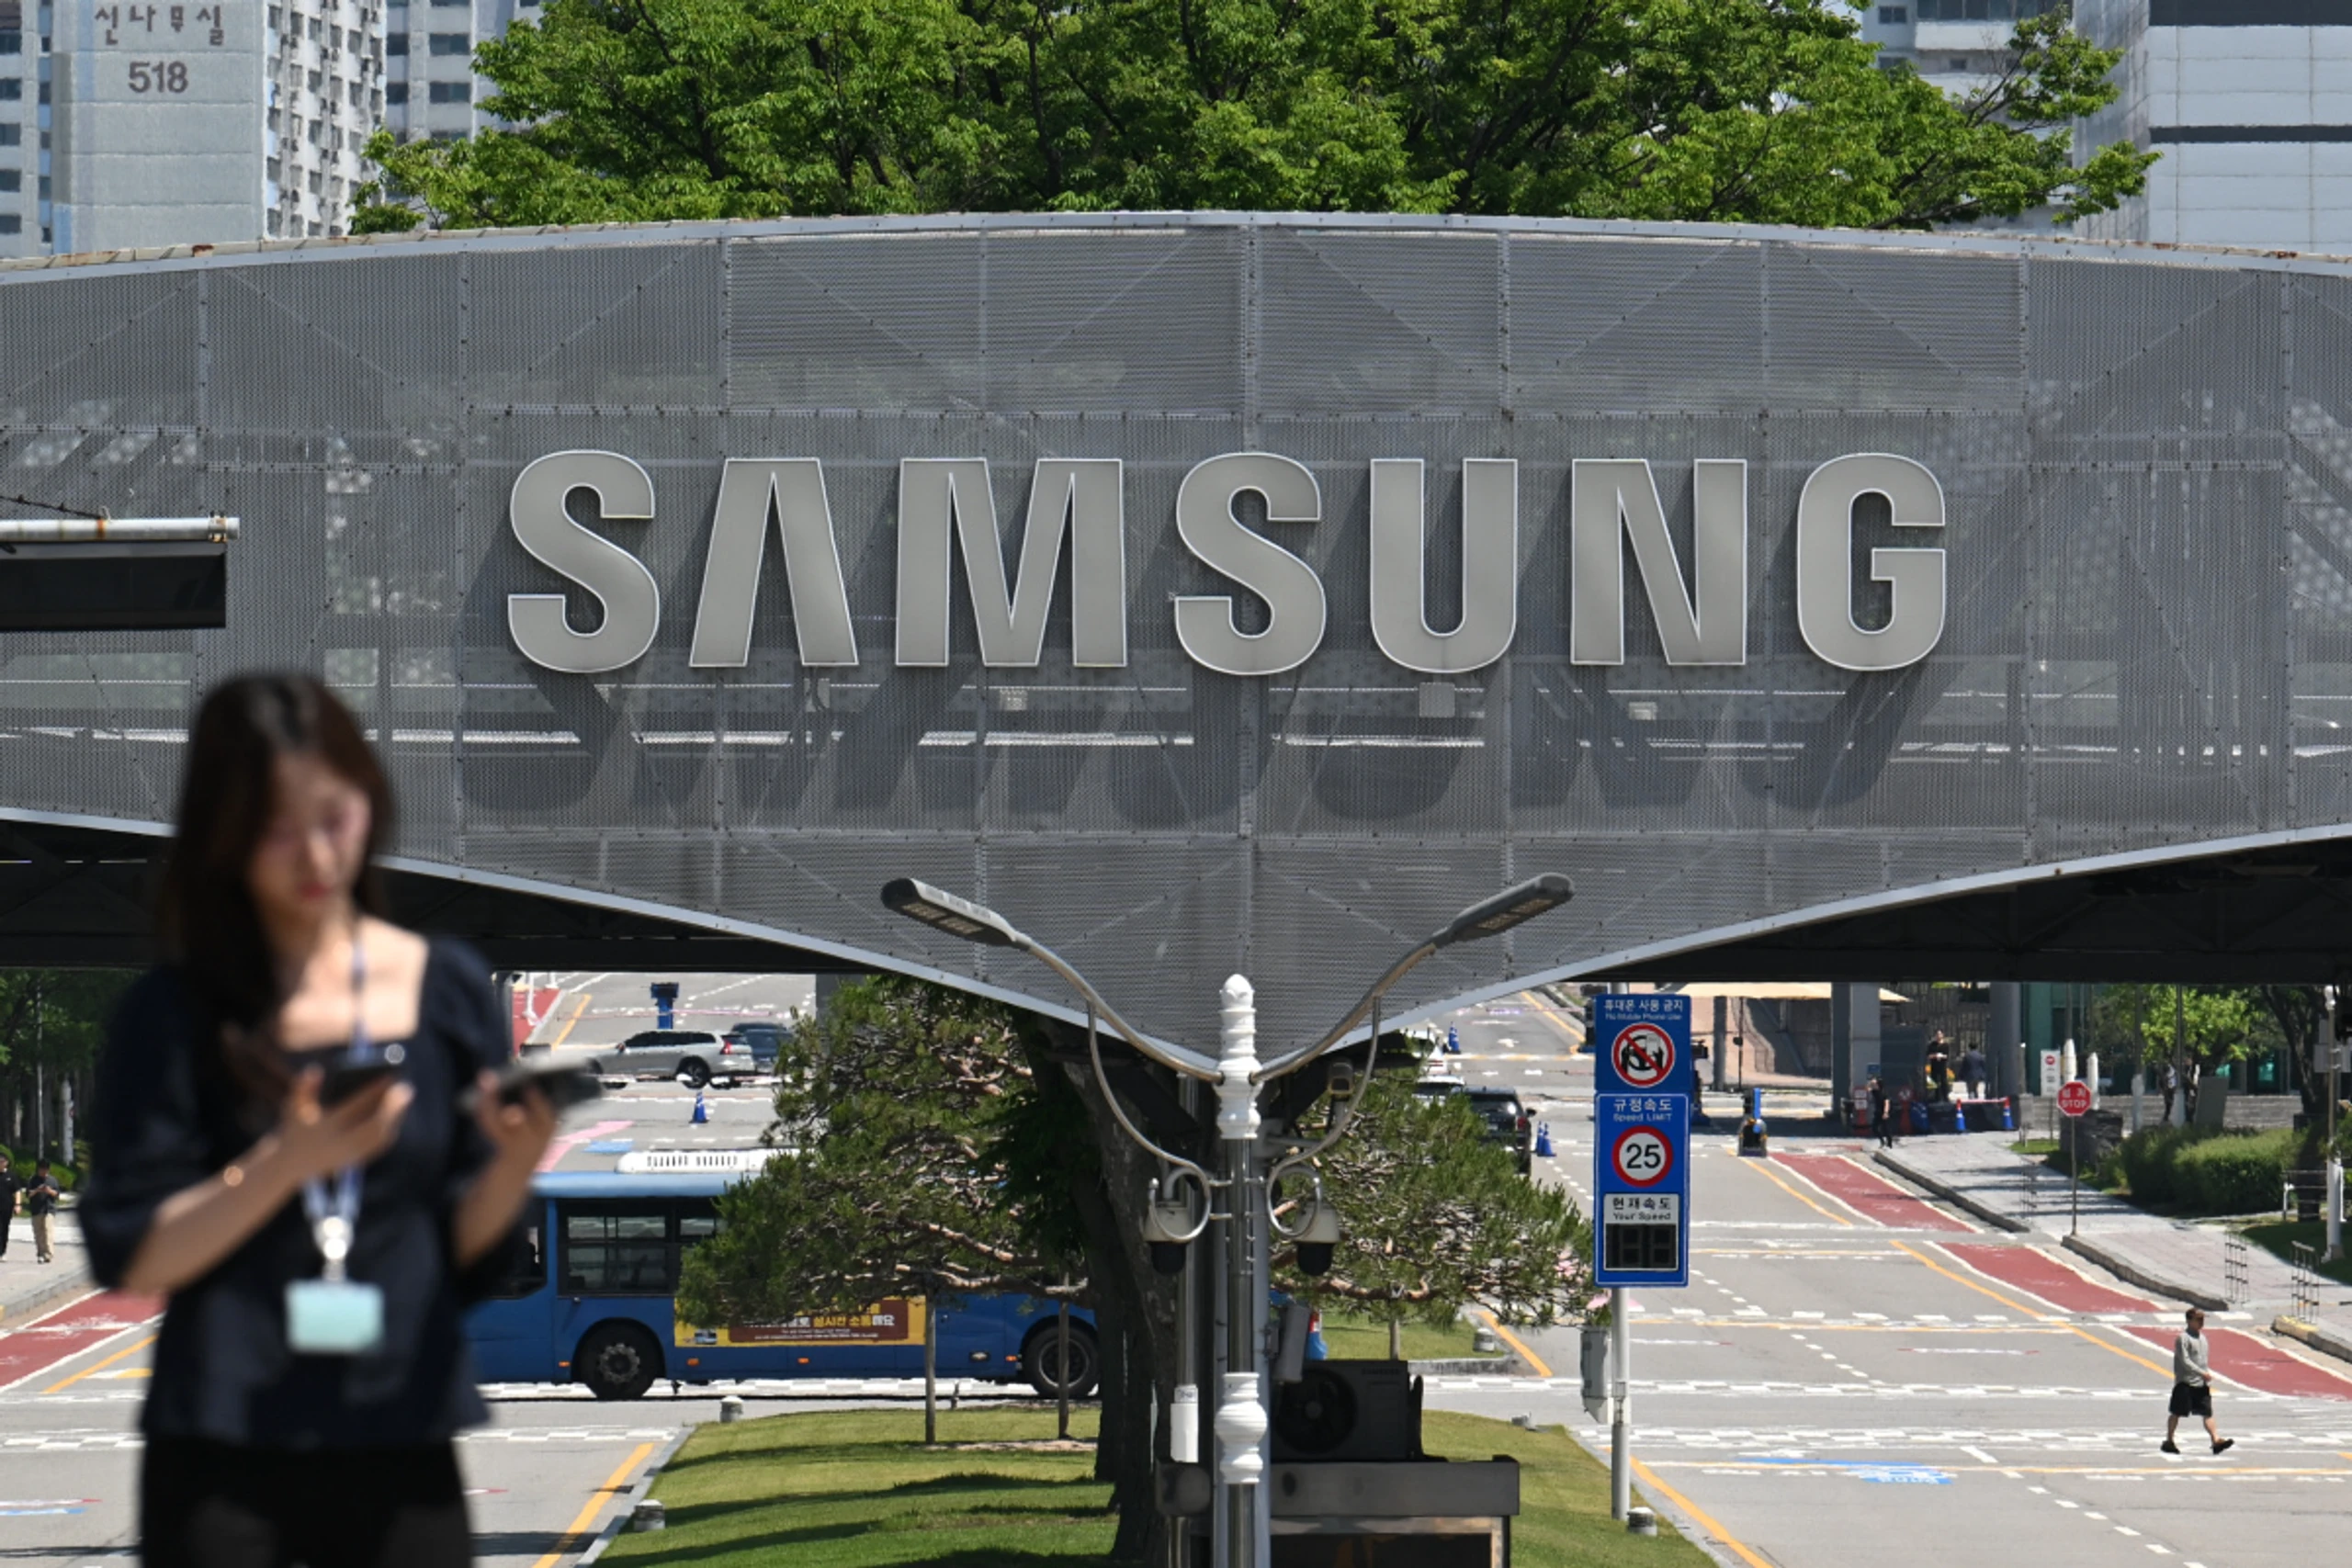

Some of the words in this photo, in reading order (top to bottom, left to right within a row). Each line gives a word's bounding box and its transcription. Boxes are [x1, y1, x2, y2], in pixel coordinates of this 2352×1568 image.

[95, 6, 224, 45] 신나무실
[129, 61, 188, 93] 518
[508, 449, 1946, 677] SAMSUNG
[1604, 998, 1635, 1012] 휴대폰
[1639, 998, 1659, 1012] 사용
[1664, 998, 1683, 1012] 금지
[1613, 1098, 1672, 1113] 규정속도
[2061, 1100, 2087, 1109] STOP
[1613, 1113, 1643, 1122] Speed
[1626, 1143, 1661, 1169] 25
[1613, 1197, 1671, 1210] 현재속도
[1613, 1213, 1635, 1221] Your
[1638, 1213, 1671, 1222] Speed
